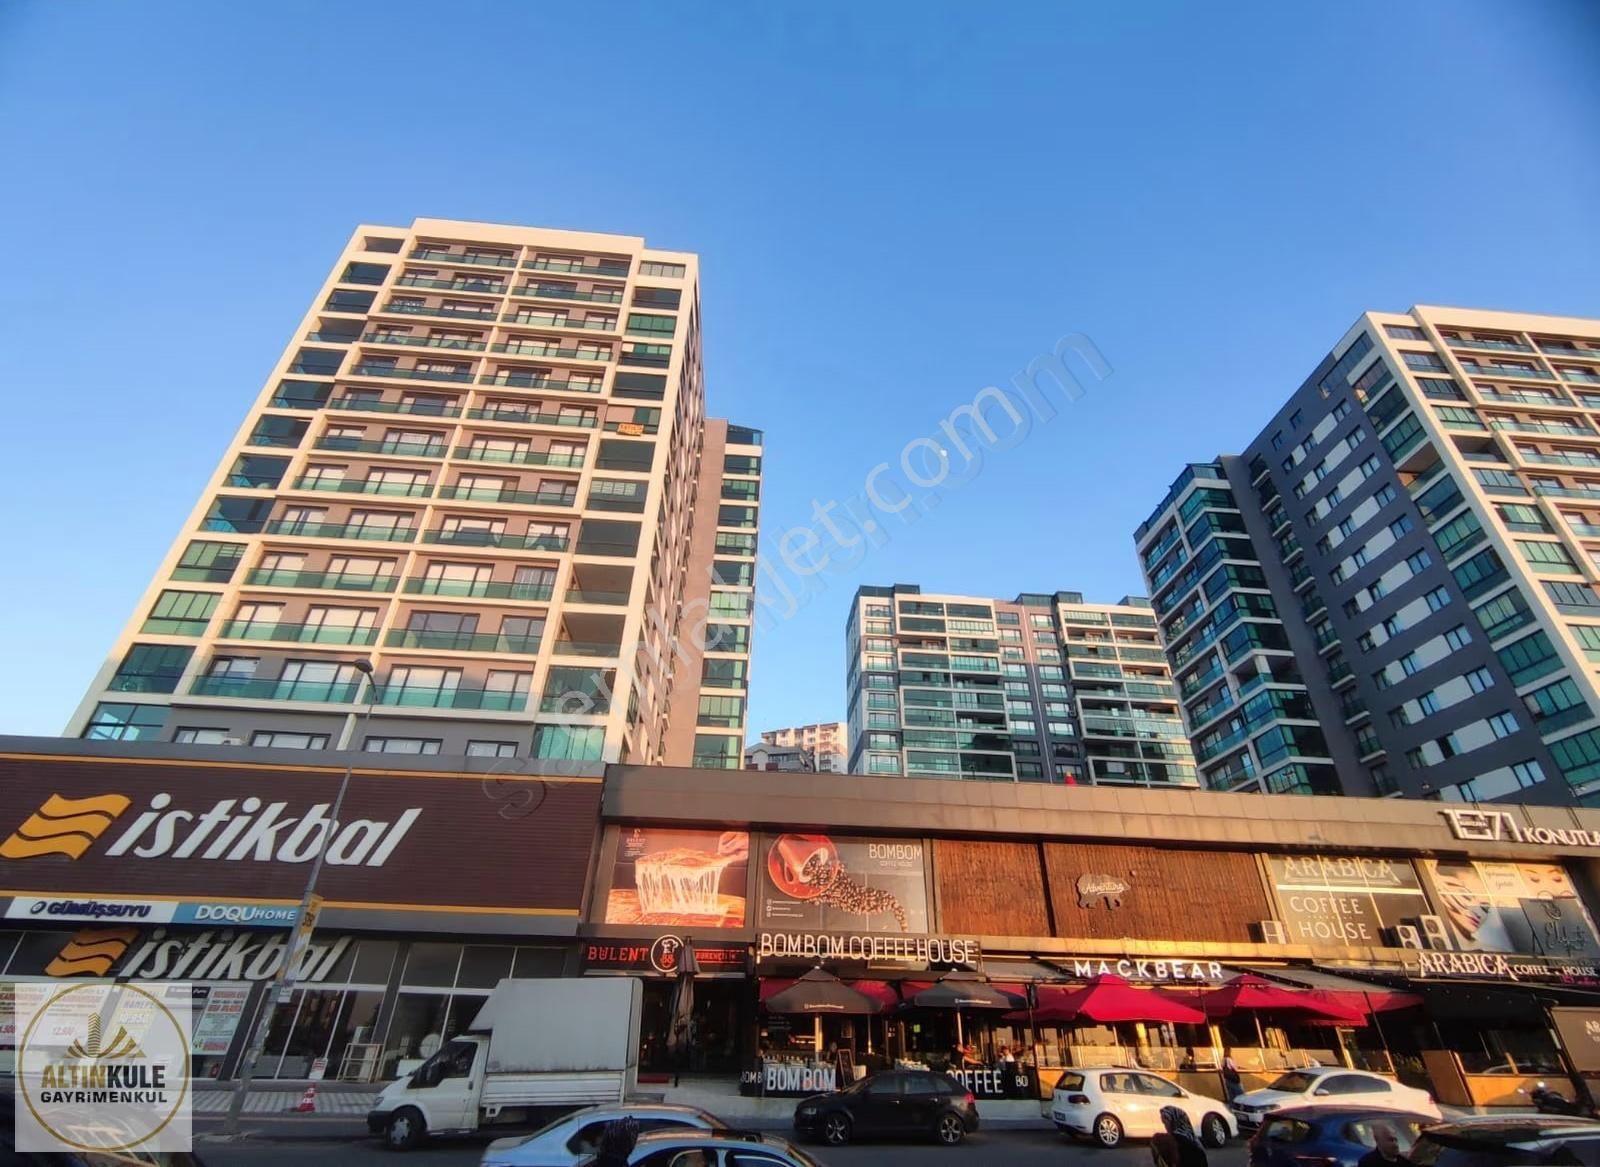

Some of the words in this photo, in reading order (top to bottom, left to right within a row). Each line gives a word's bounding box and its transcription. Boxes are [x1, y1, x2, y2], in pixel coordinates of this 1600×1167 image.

[104, 792, 423, 867] istikbal
[1284, 856, 1400, 883] ARABICA
[1290, 896, 1364, 915] COFFEE
[1298, 921, 1371, 940] HOUSE
[1074, 959, 1224, 979] MACKBEAR
[1419, 951, 1519, 981] ARABICA
[1514, 964, 1550, 976] COFFEE
[1562, 966, 1599, 977] HOUSE
